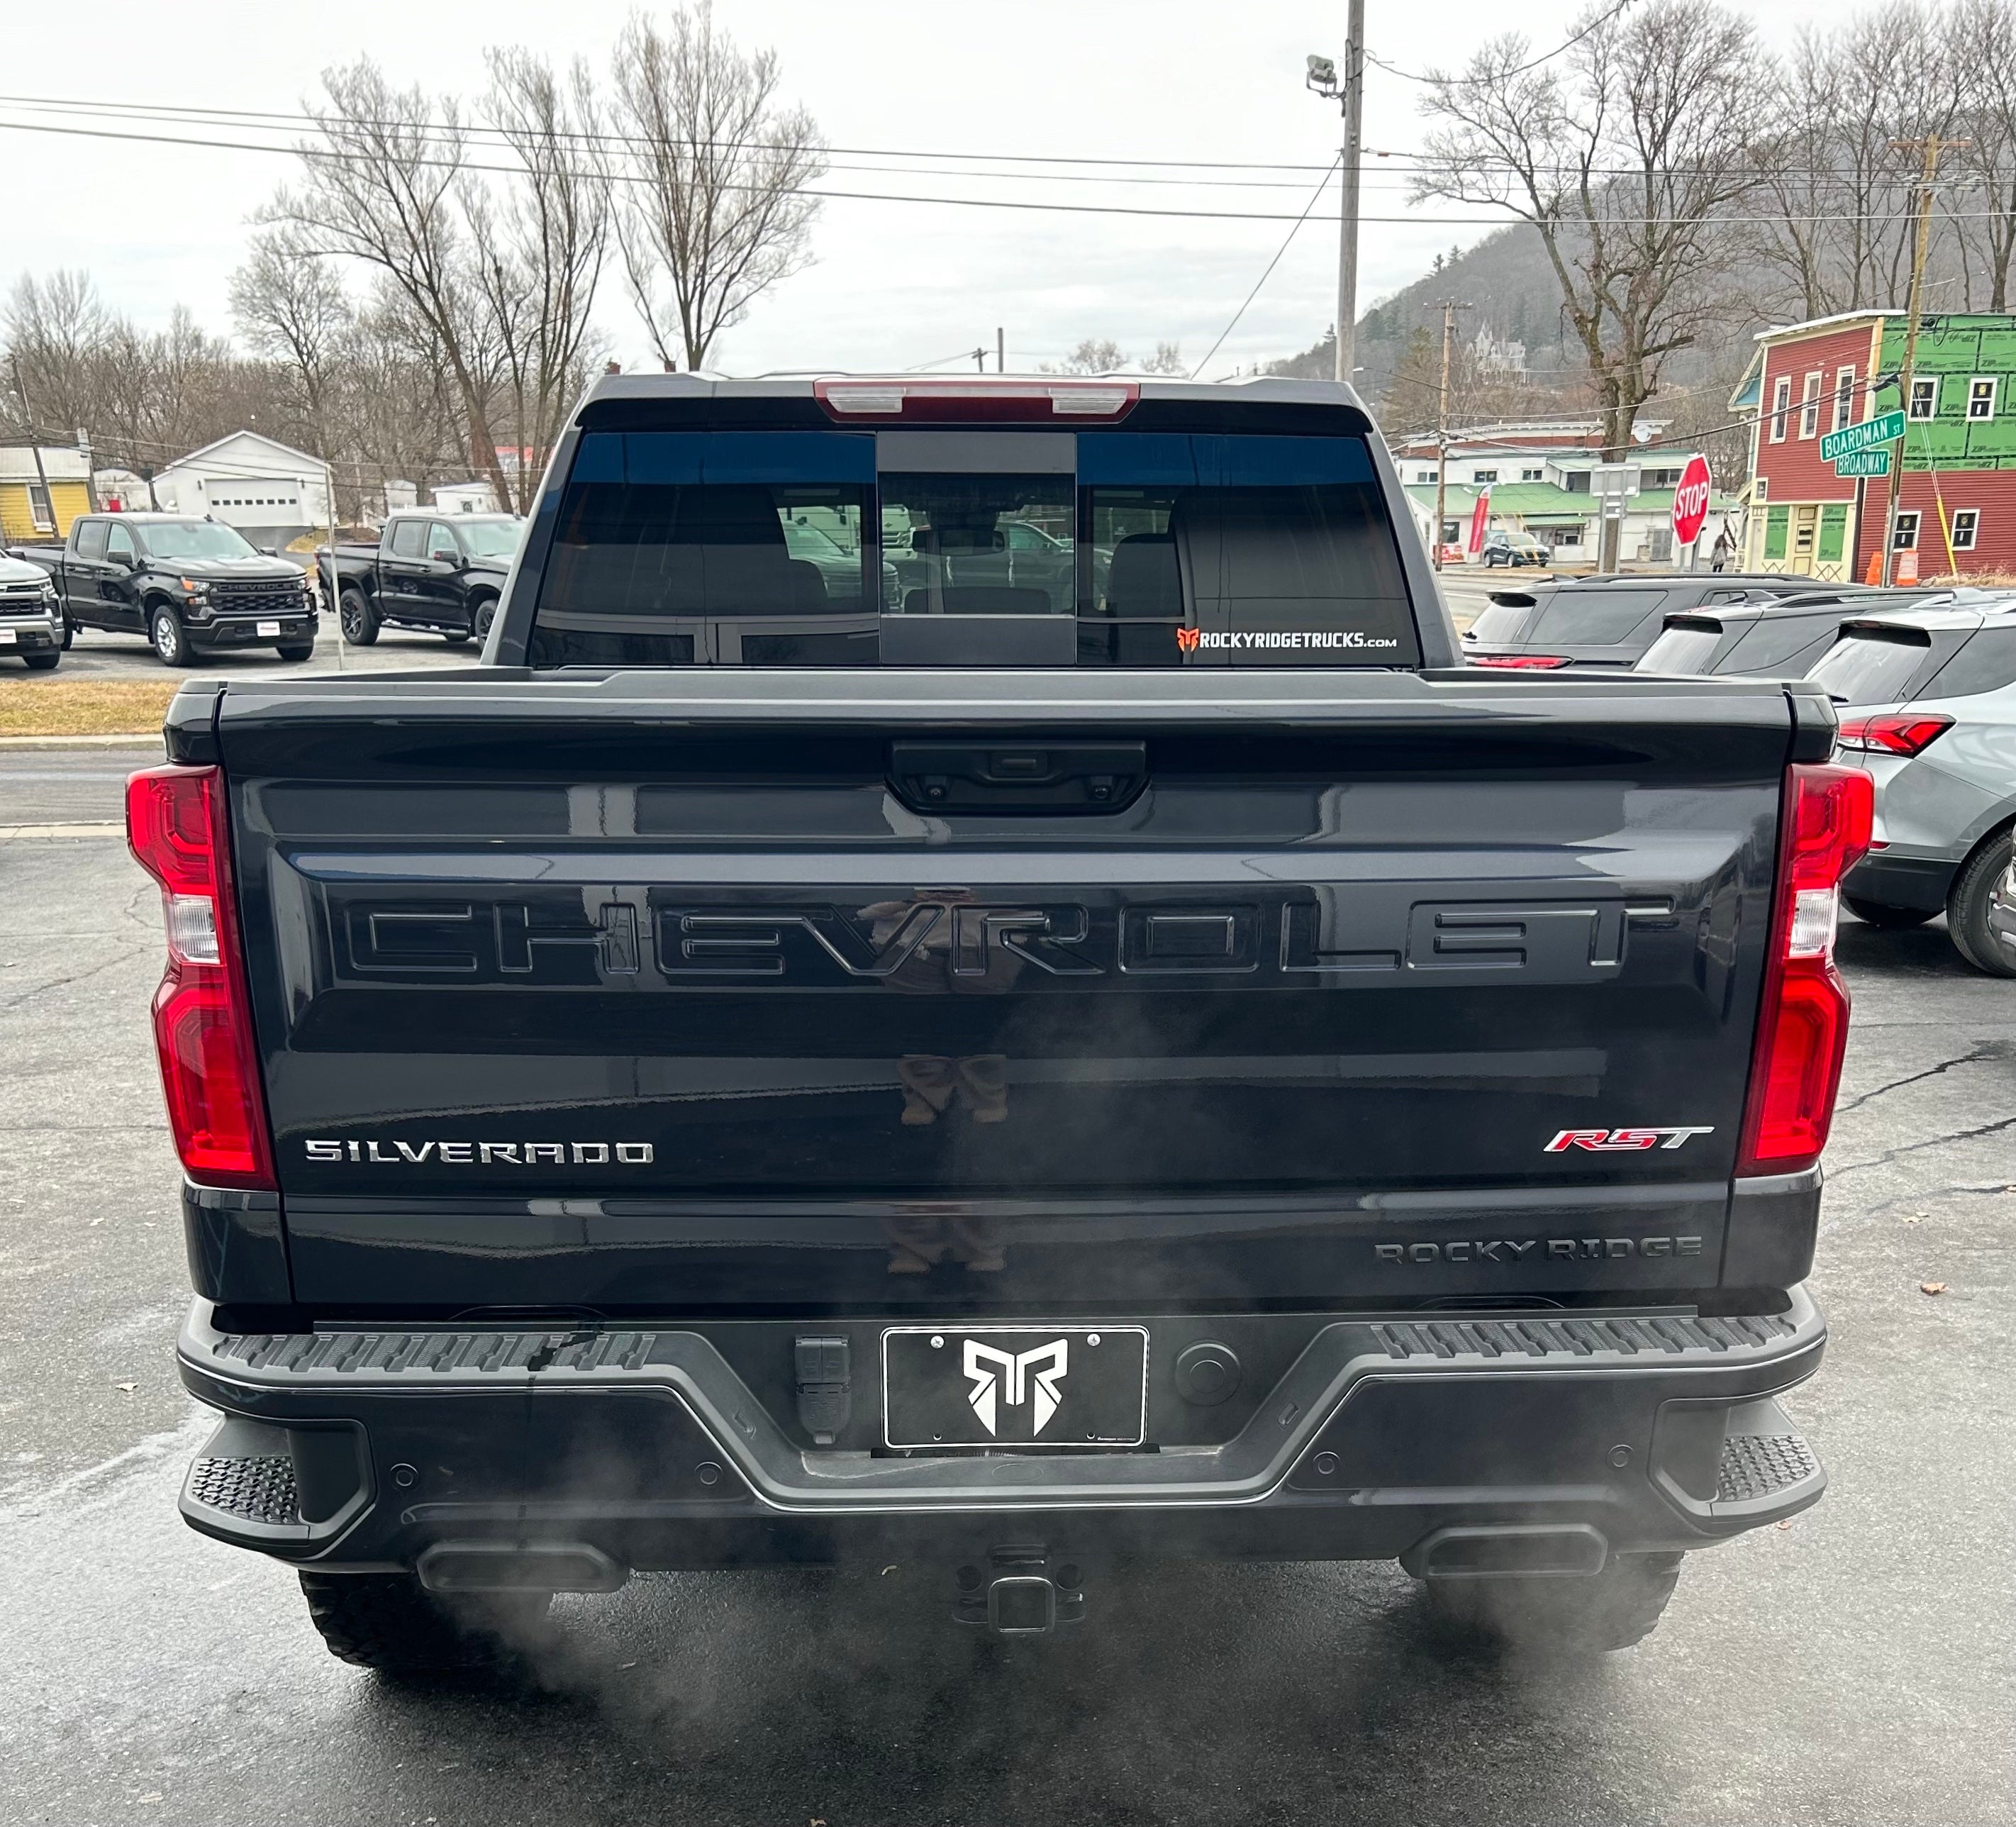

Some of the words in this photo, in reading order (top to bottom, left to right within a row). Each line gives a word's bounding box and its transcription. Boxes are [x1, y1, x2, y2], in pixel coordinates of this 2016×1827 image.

[1825, 419, 1888, 457] BOARDMAN
[1893, 423, 1900, 435] ST
[1838, 453, 1886, 474] BROADWAY
[1676, 482, 1708, 521] STOP
[1199, 632, 1397, 648] ROCKYRIDGETRUCKS.COM
[347, 896, 1675, 976] CHEVROLET
[305, 1140, 654, 1164] SILVERADO
[1543, 1126, 1715, 1153] RST
[1374, 1240, 1536, 1265] ROCKY
[1546, 1235, 1702, 1262] RIDGE
